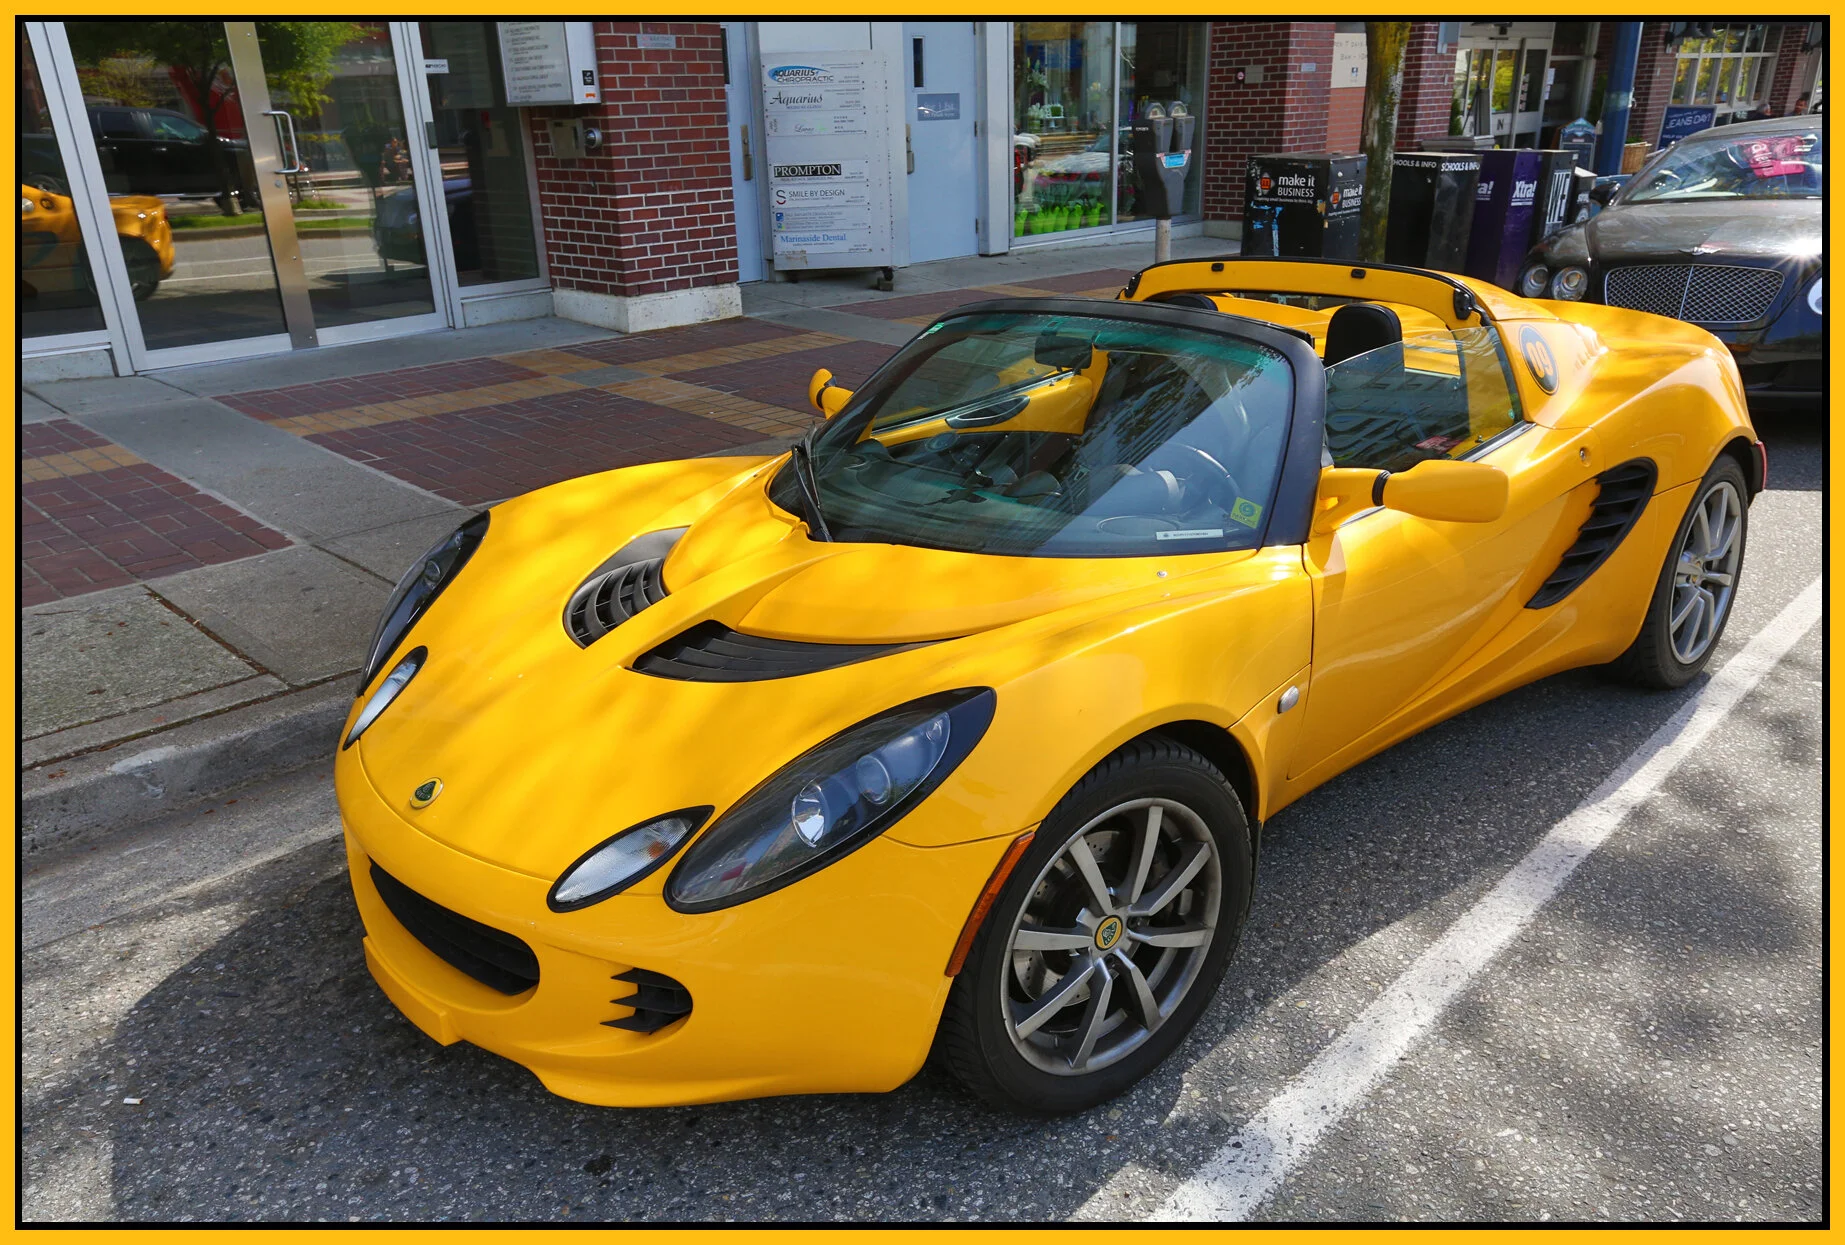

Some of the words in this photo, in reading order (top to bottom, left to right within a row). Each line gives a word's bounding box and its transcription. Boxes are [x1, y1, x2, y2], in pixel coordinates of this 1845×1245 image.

[773, 69, 815, 77] AQUARIUS
[777, 75, 834, 83] CHIROPRACTIC
[769, 91, 823, 106] Aquarius
[1421, 161, 1437, 169] INFO
[1441, 162, 1464, 171] SCHOOLS
[774, 164, 841, 177] PROMPTON
[1278, 173, 1305, 187] make
[1308, 174, 1315, 187] it
[789, 190, 809, 198] SMILE
[810, 189, 819, 197] BY
[820, 189, 846, 197] DESIGN
[1277, 187, 1315, 198] BUSINESS
[1343, 188, 1358, 198] make
[1512, 180, 1538, 198] Xtra!
[1342, 197, 1362, 208] BUSINESS
[780, 234, 820, 243] Marinaside
[822, 233, 847, 241] Dental
[1525, 341, 1554, 379] 09
